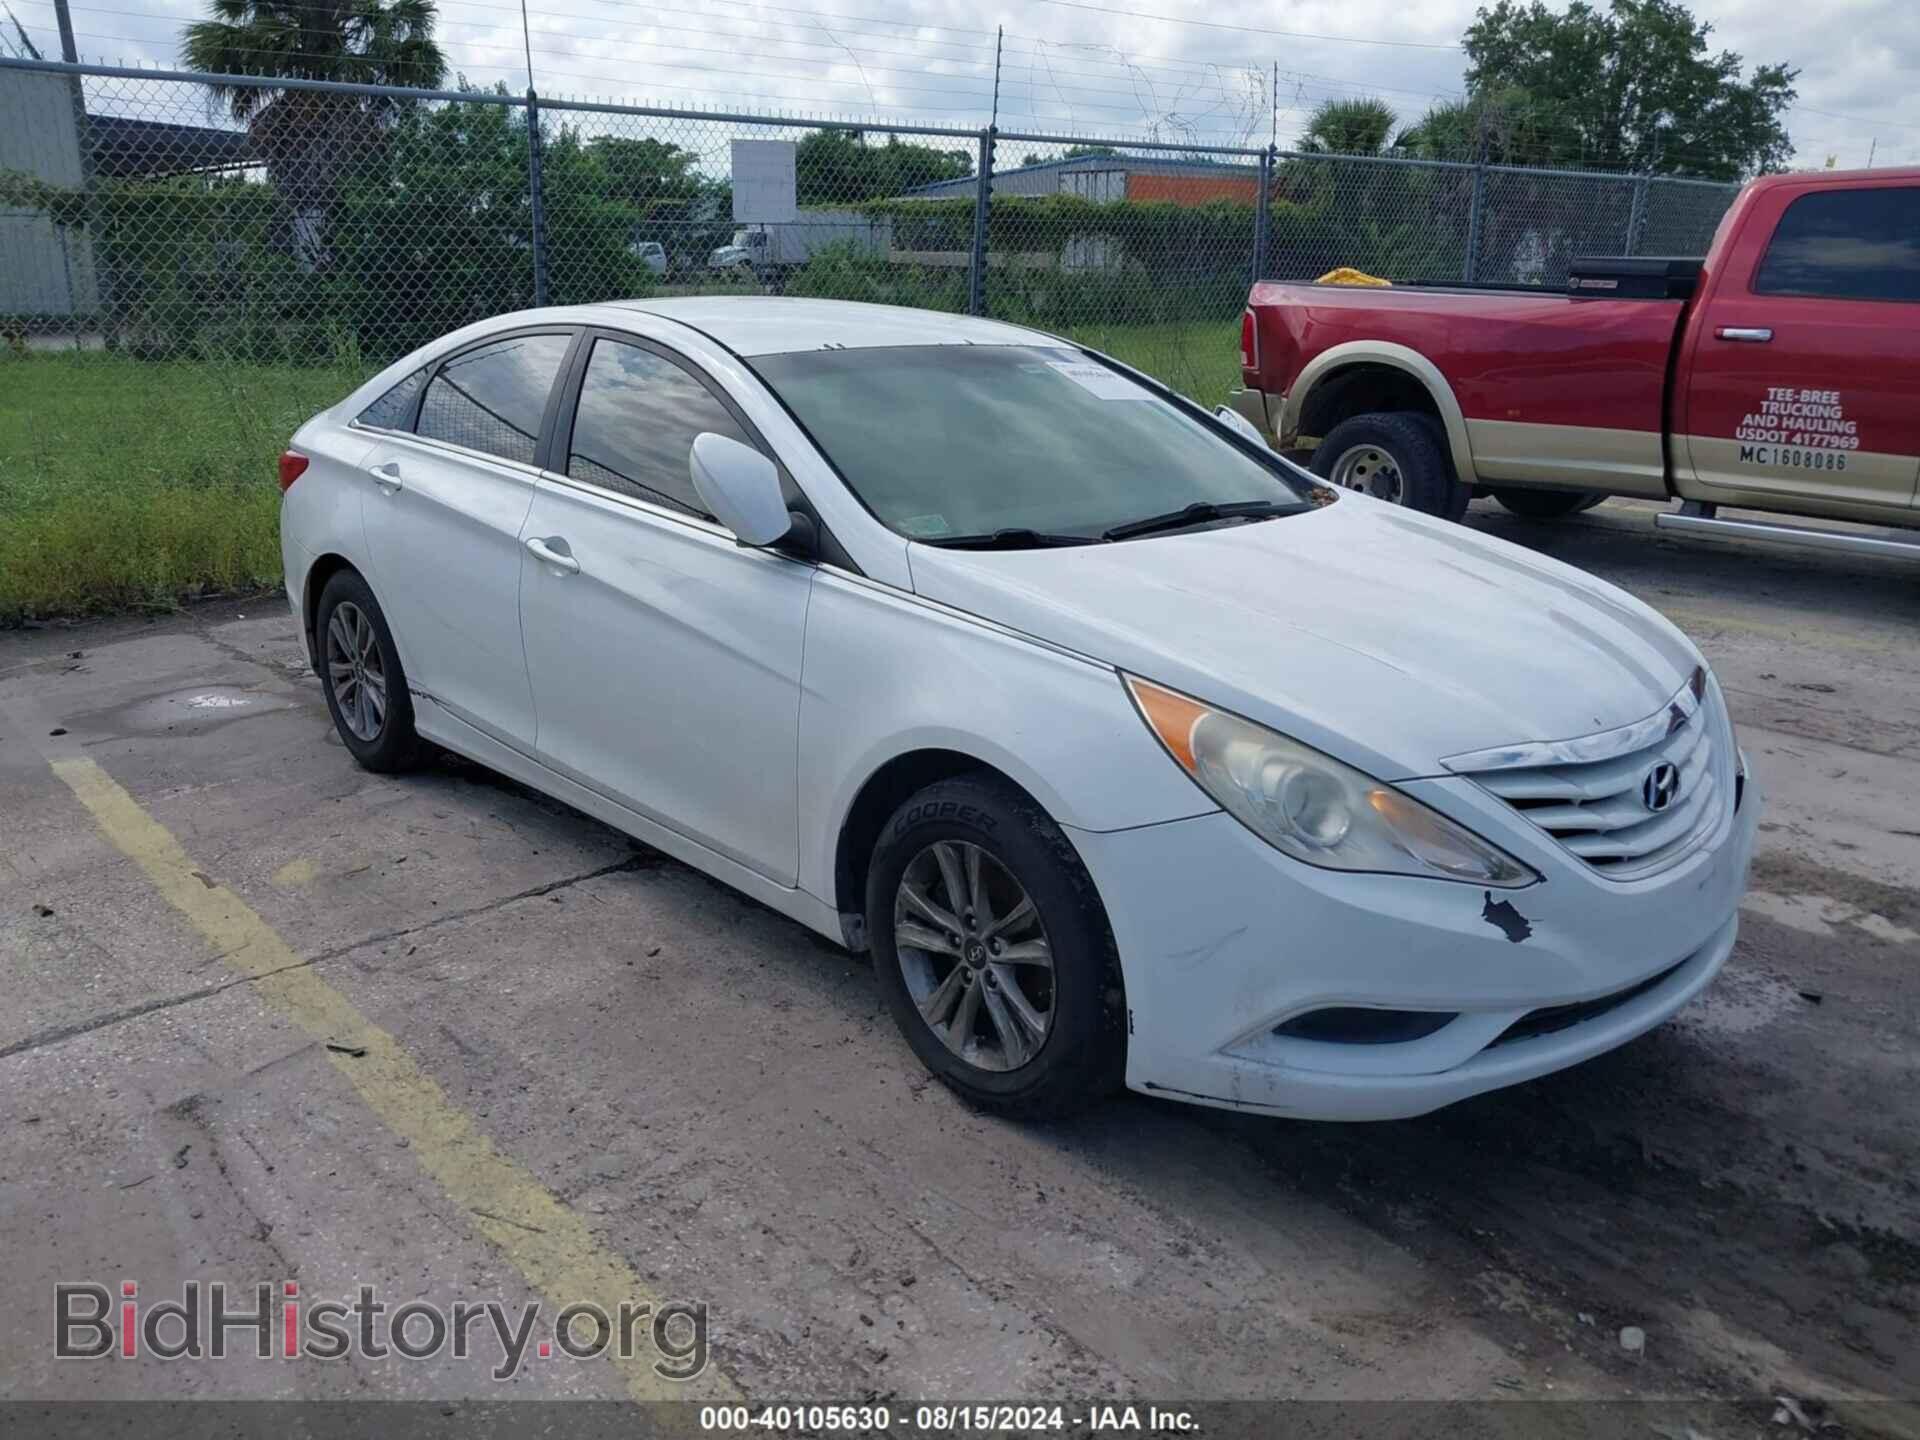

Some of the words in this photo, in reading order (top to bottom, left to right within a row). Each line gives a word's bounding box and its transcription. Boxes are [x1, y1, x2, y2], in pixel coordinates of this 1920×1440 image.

[1767, 387, 1840, 405] TEE-BREE
[1760, 401, 1842, 419] TRUCKING
[1742, 413, 1778, 428] AND
[1781, 417, 1857, 434] HAULING
[1735, 427, 1789, 442] USDOT
[894, 800, 999, 836] COOPER
